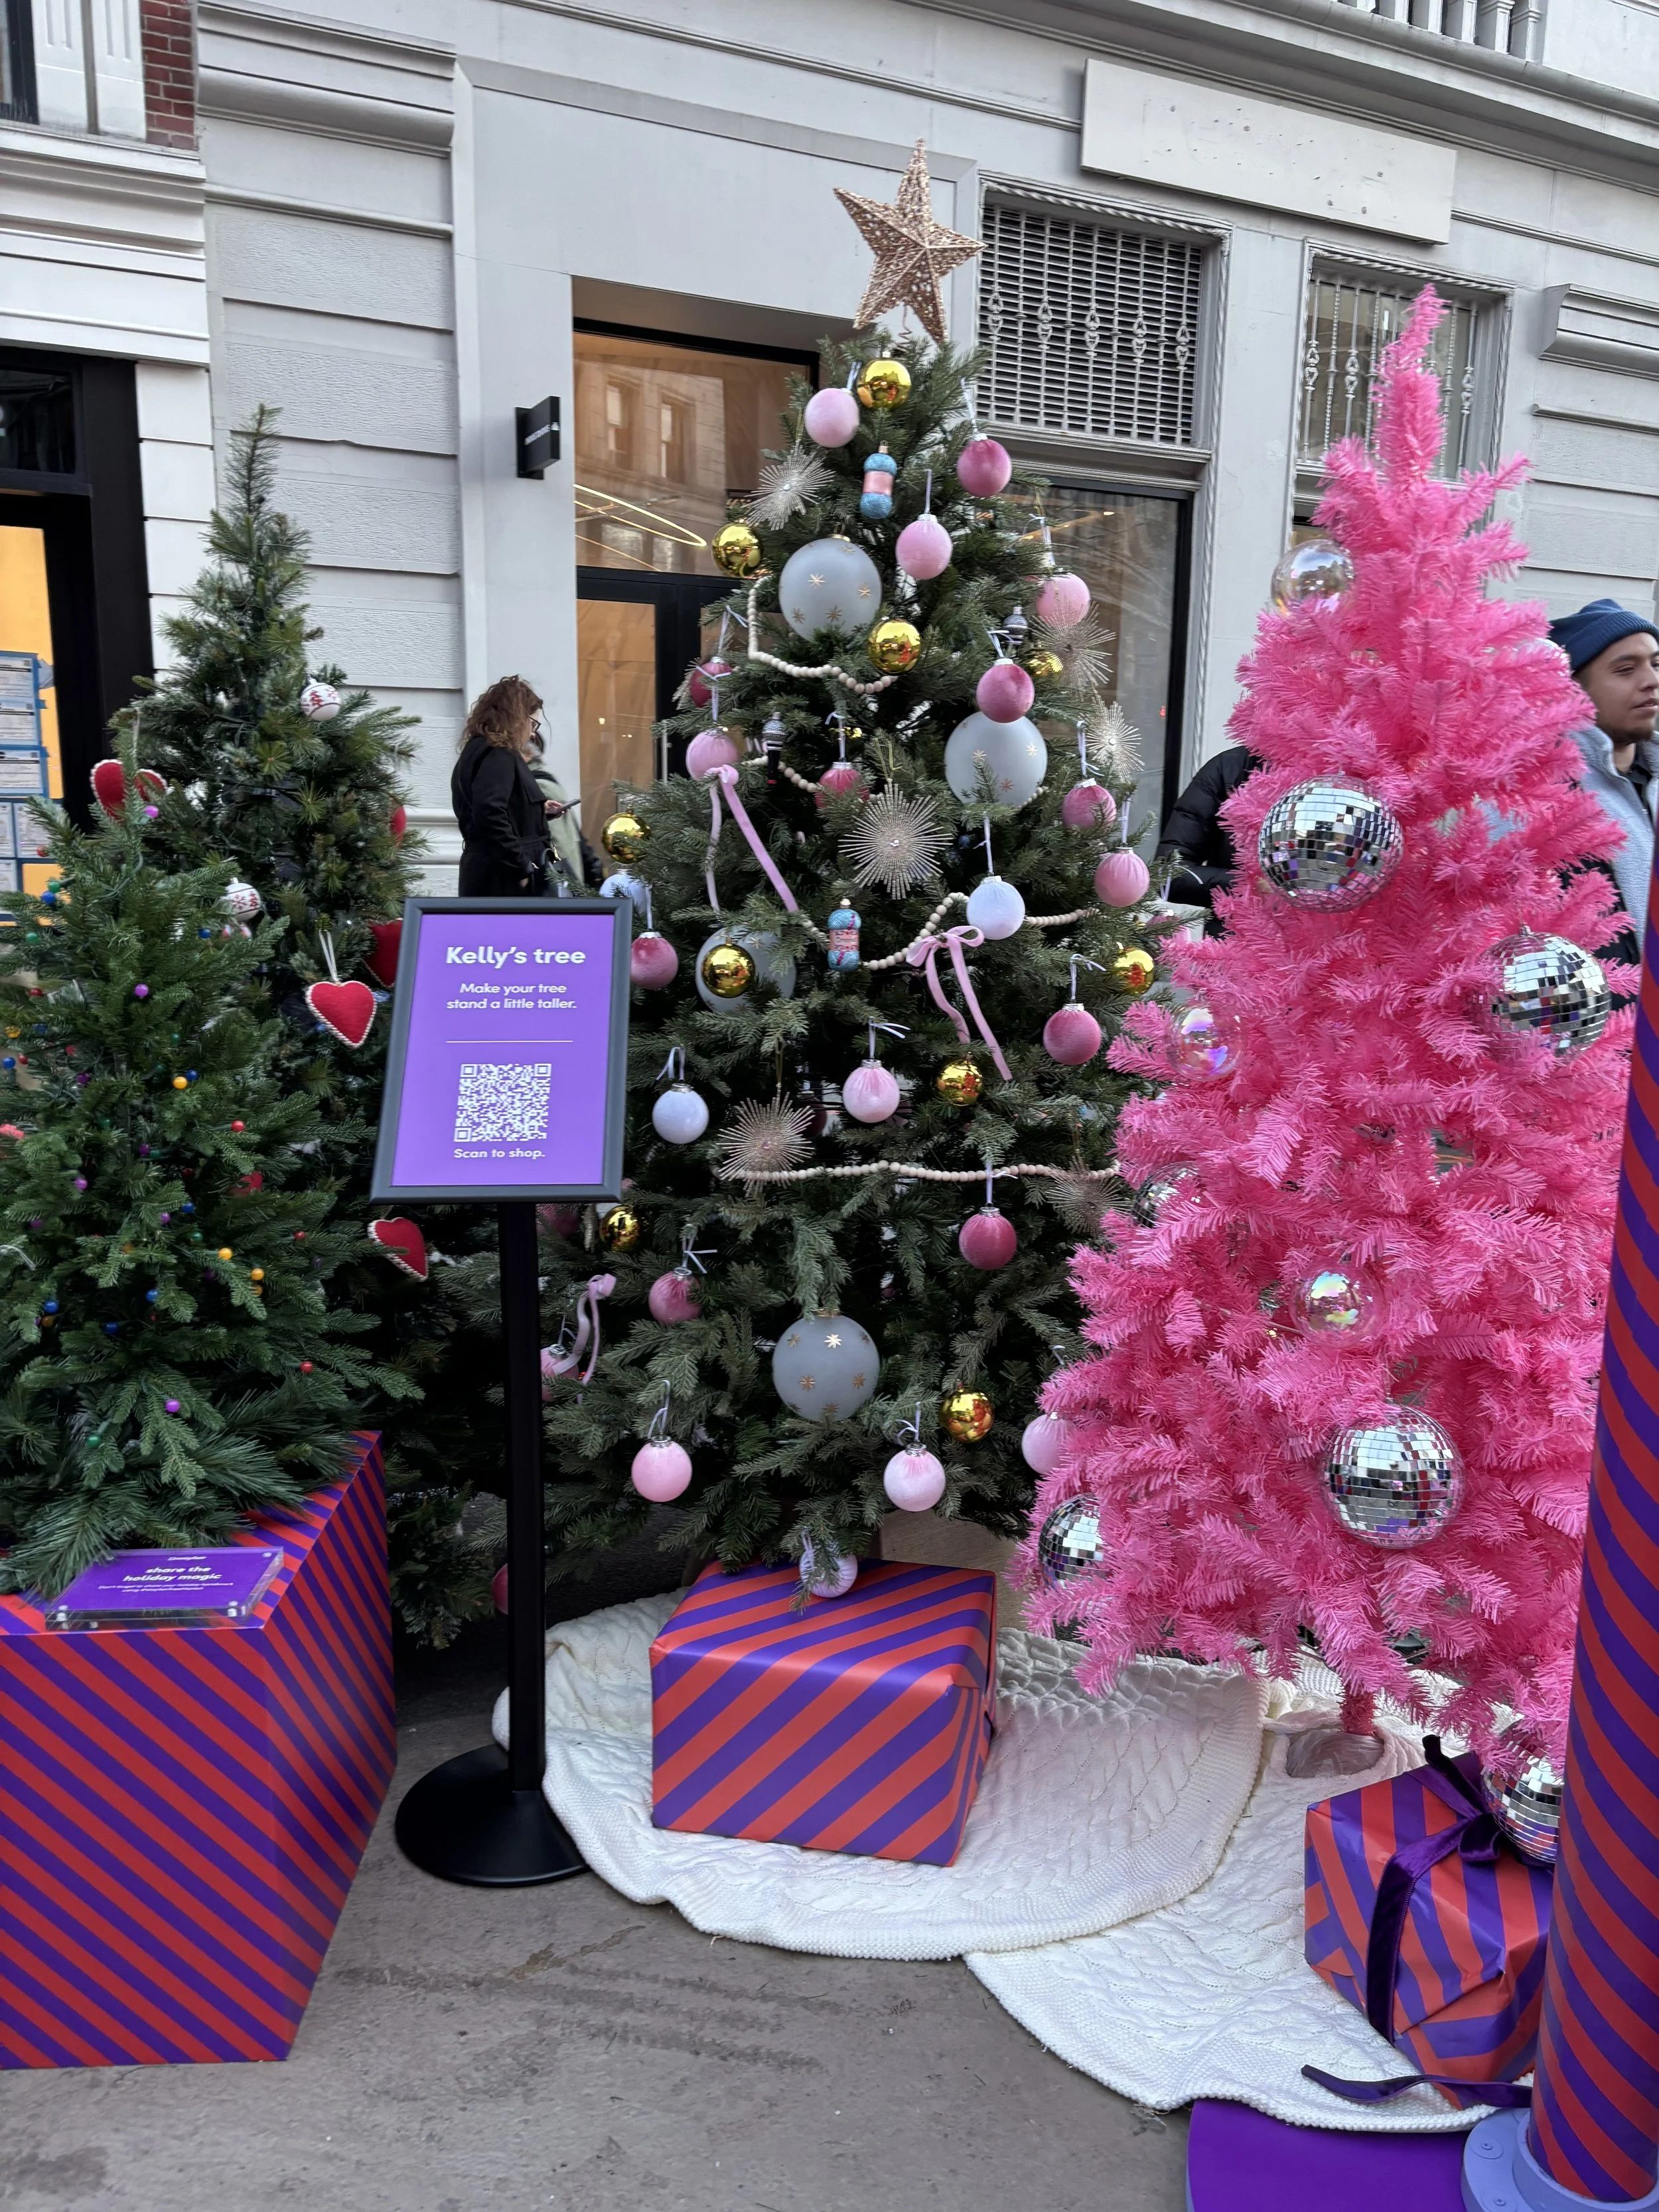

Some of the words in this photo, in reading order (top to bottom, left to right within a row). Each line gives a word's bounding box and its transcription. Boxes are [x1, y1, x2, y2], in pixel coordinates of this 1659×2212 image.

[446, 946, 528, 969] Kelly's
[533, 948, 586, 964] tree
[459, 983, 500, 993] Make
[503, 985, 536, 995] your
[538, 984, 567, 993] tree
[446, 998, 488, 1009] stand
[490, 1000, 500, 1009] a
[504, 998, 535, 1009] little
[538, 998, 577, 1009] taller.
[453, 1148, 488, 1158] Scan
[491, 1149, 506, 1158] to
[508, 1148, 545, 1160] shop.
